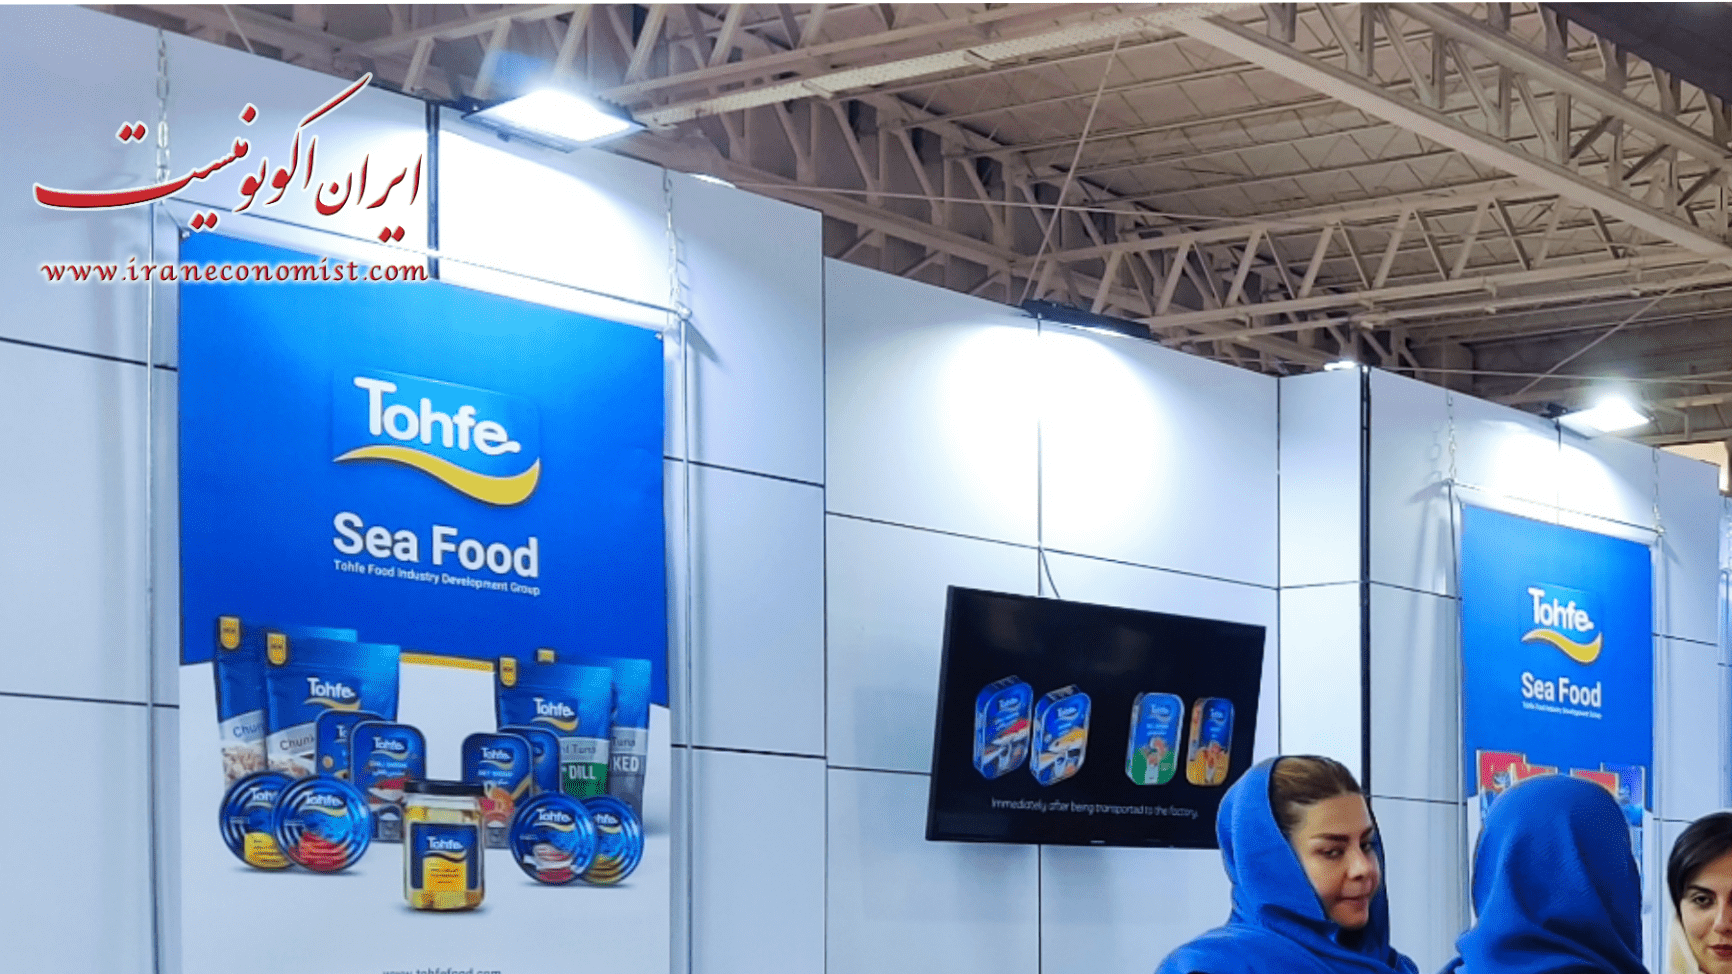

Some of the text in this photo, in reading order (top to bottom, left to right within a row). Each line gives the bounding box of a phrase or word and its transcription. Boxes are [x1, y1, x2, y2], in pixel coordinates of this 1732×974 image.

[353, 376, 521, 455] Tohfe
[333, 511, 539, 579] Sea Food
[333, 559, 541, 598] Tohfe Food Industry Development Group
[1527, 587, 1595, 632] Tohfe
[1521, 671, 1602, 708] Sea Food
